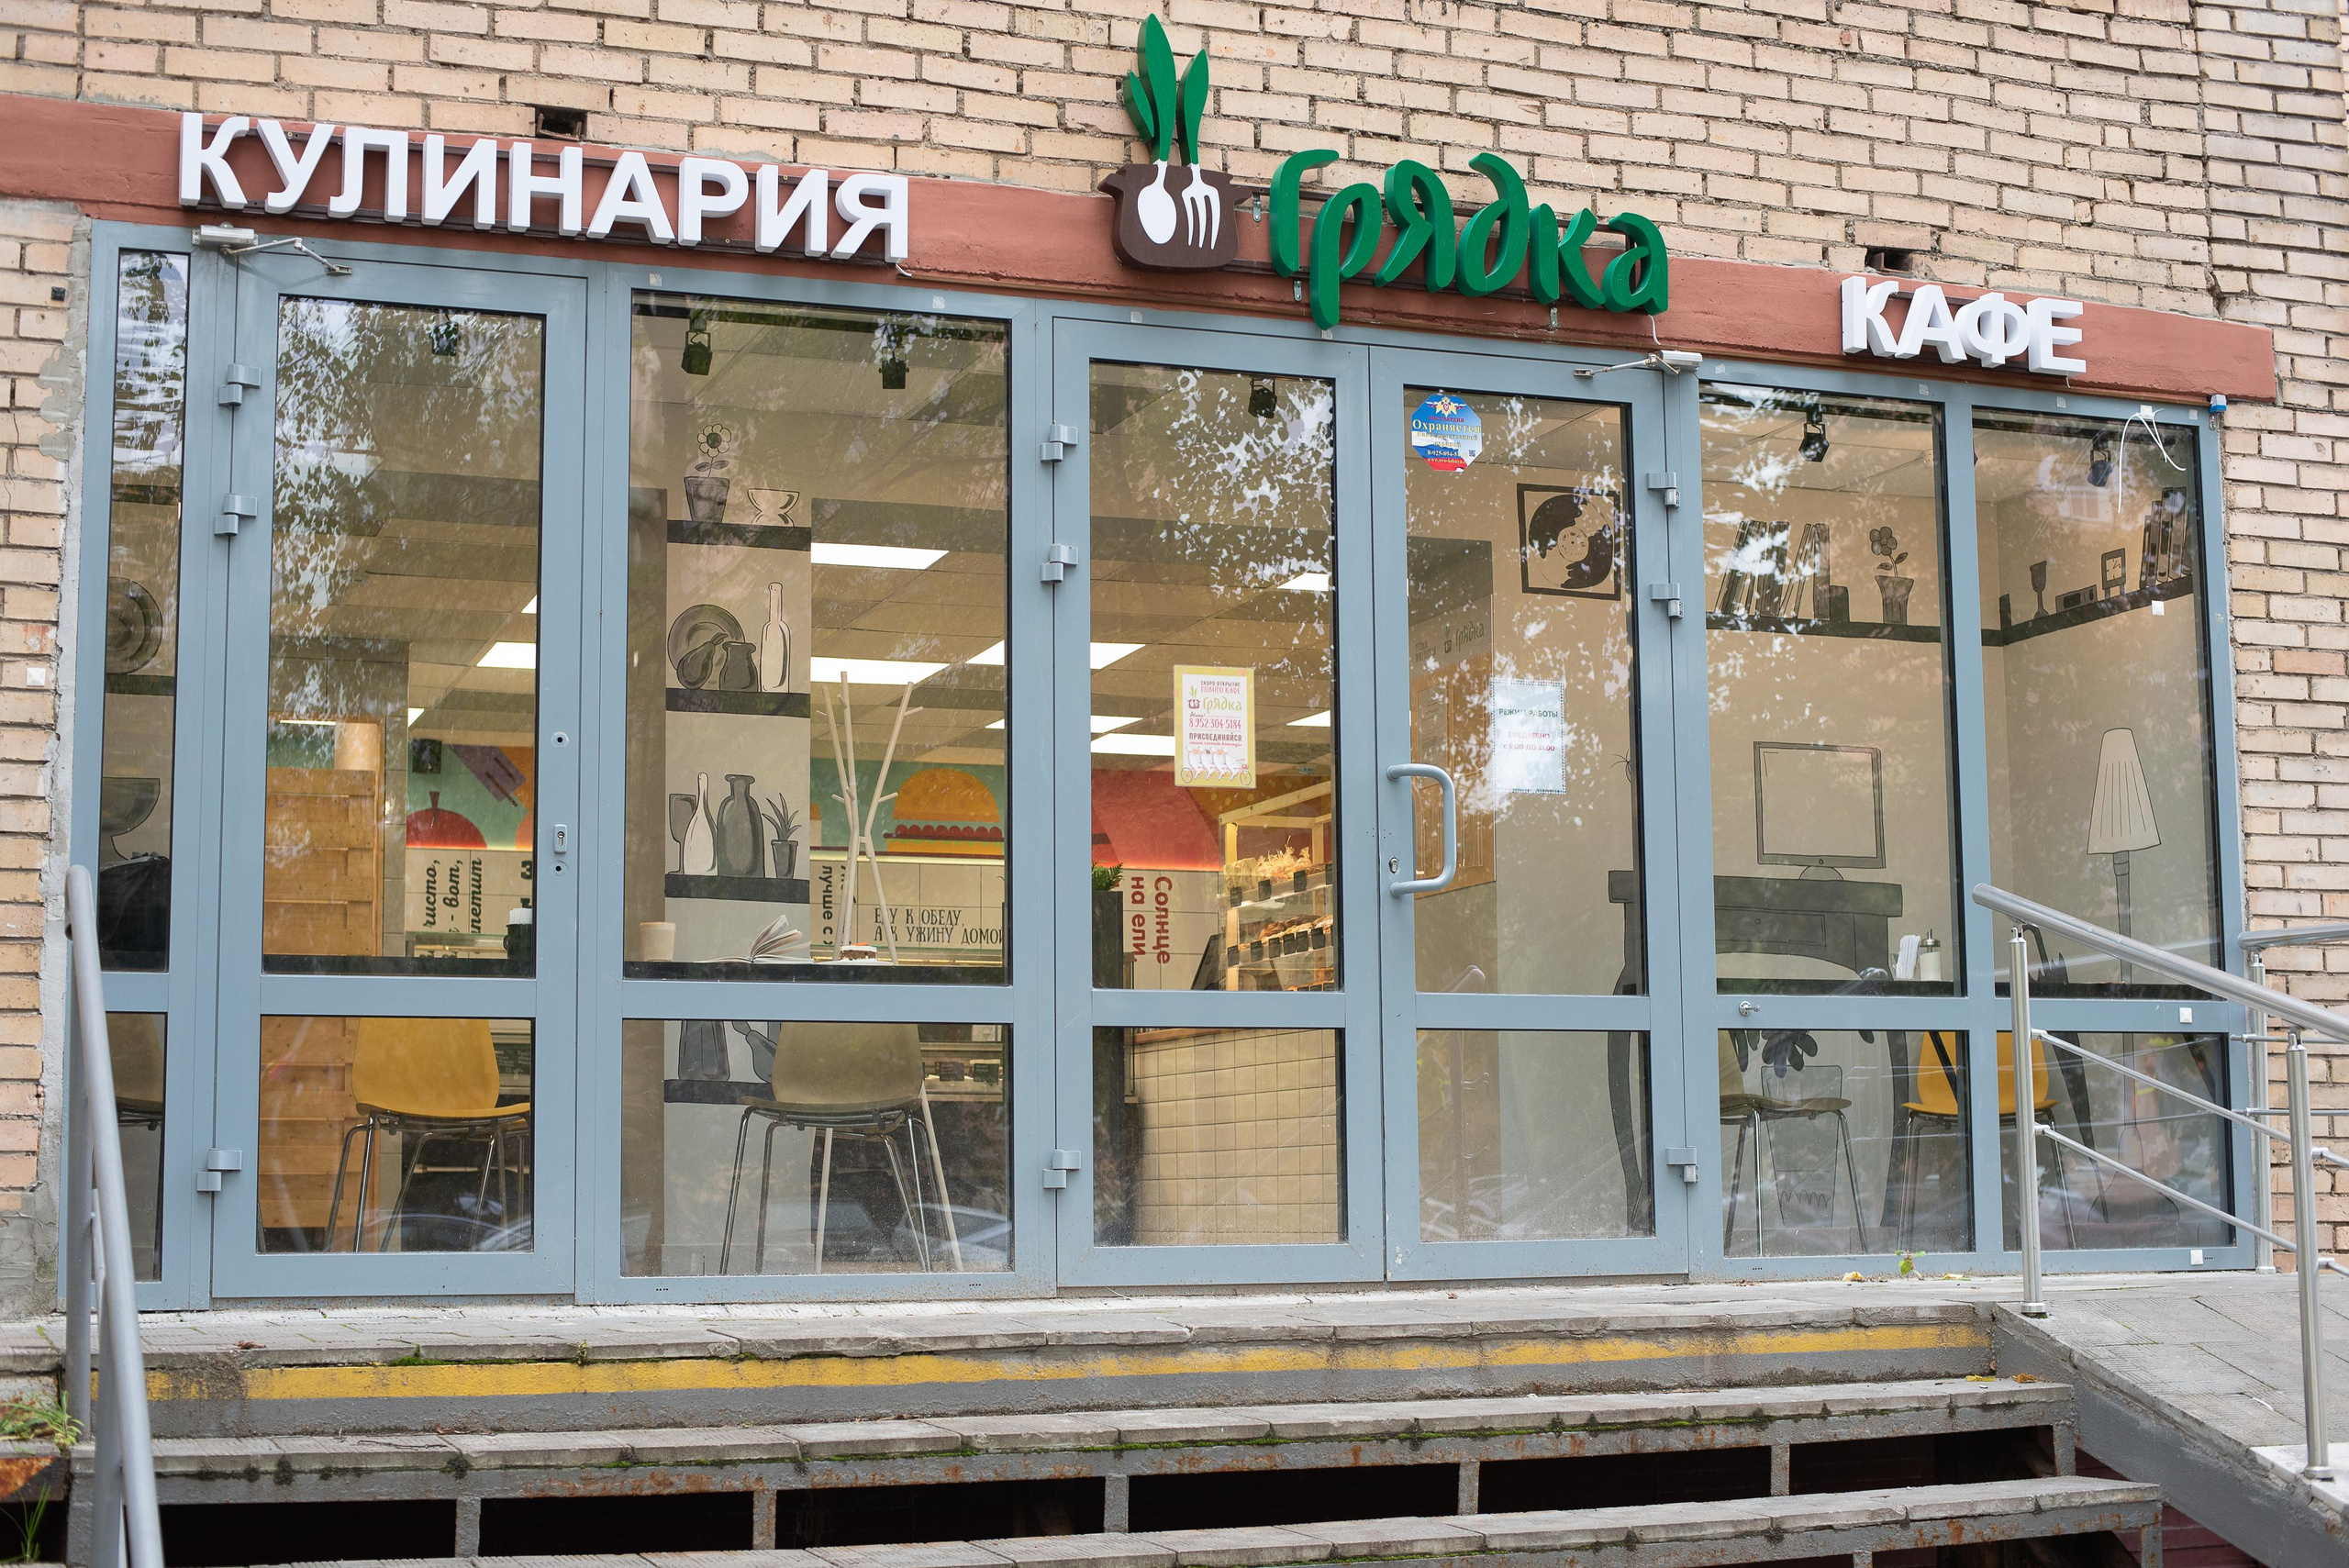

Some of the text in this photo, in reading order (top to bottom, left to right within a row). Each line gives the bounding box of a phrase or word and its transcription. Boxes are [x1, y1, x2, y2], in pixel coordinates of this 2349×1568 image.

[179, 112, 908, 262] КУЛИНАРИЯ
[1269, 150, 1668, 330] Грядка
[1842, 275, 2086, 375] КАФЕ
[1412, 419, 1480, 433] Охраняется
[1203, 696, 1241, 713] Грядка
[1225, 719, 1241, 729] 5184
[1189, 732, 1241, 741] ПРИСОЕДИНЯЙСЯ
[819, 865, 834, 920] лучше
[1131, 877, 1145, 904] на
[874, 907, 898, 925] ЕУ
[921, 909, 964, 927] ОБЕДУ,
[1152, 876, 1173, 964] Солнце
[907, 927, 954, 942] УЖИНУ
